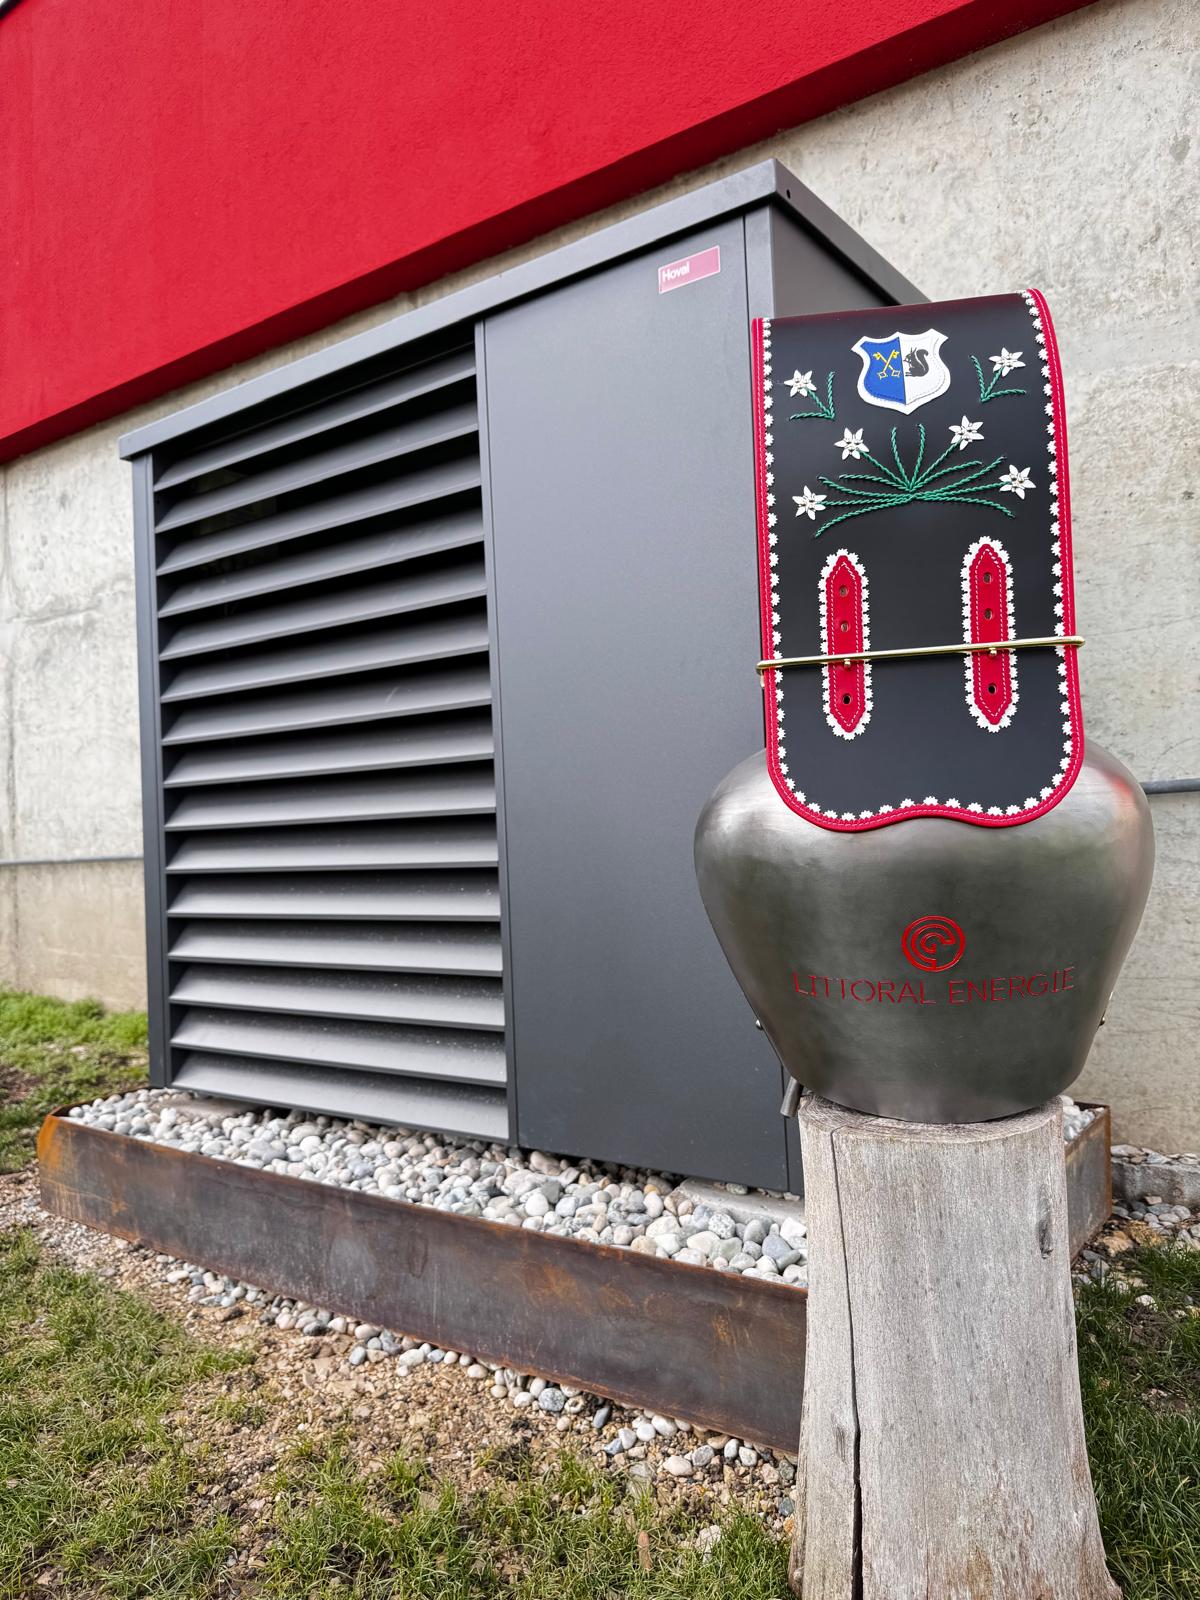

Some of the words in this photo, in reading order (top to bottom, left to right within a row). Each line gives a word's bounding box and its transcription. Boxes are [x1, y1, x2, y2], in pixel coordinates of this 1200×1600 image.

[662, 261, 690, 282] Hoval
[792, 971, 937, 1005] LITTORAL
[949, 966, 1076, 1004] ENERGIE
